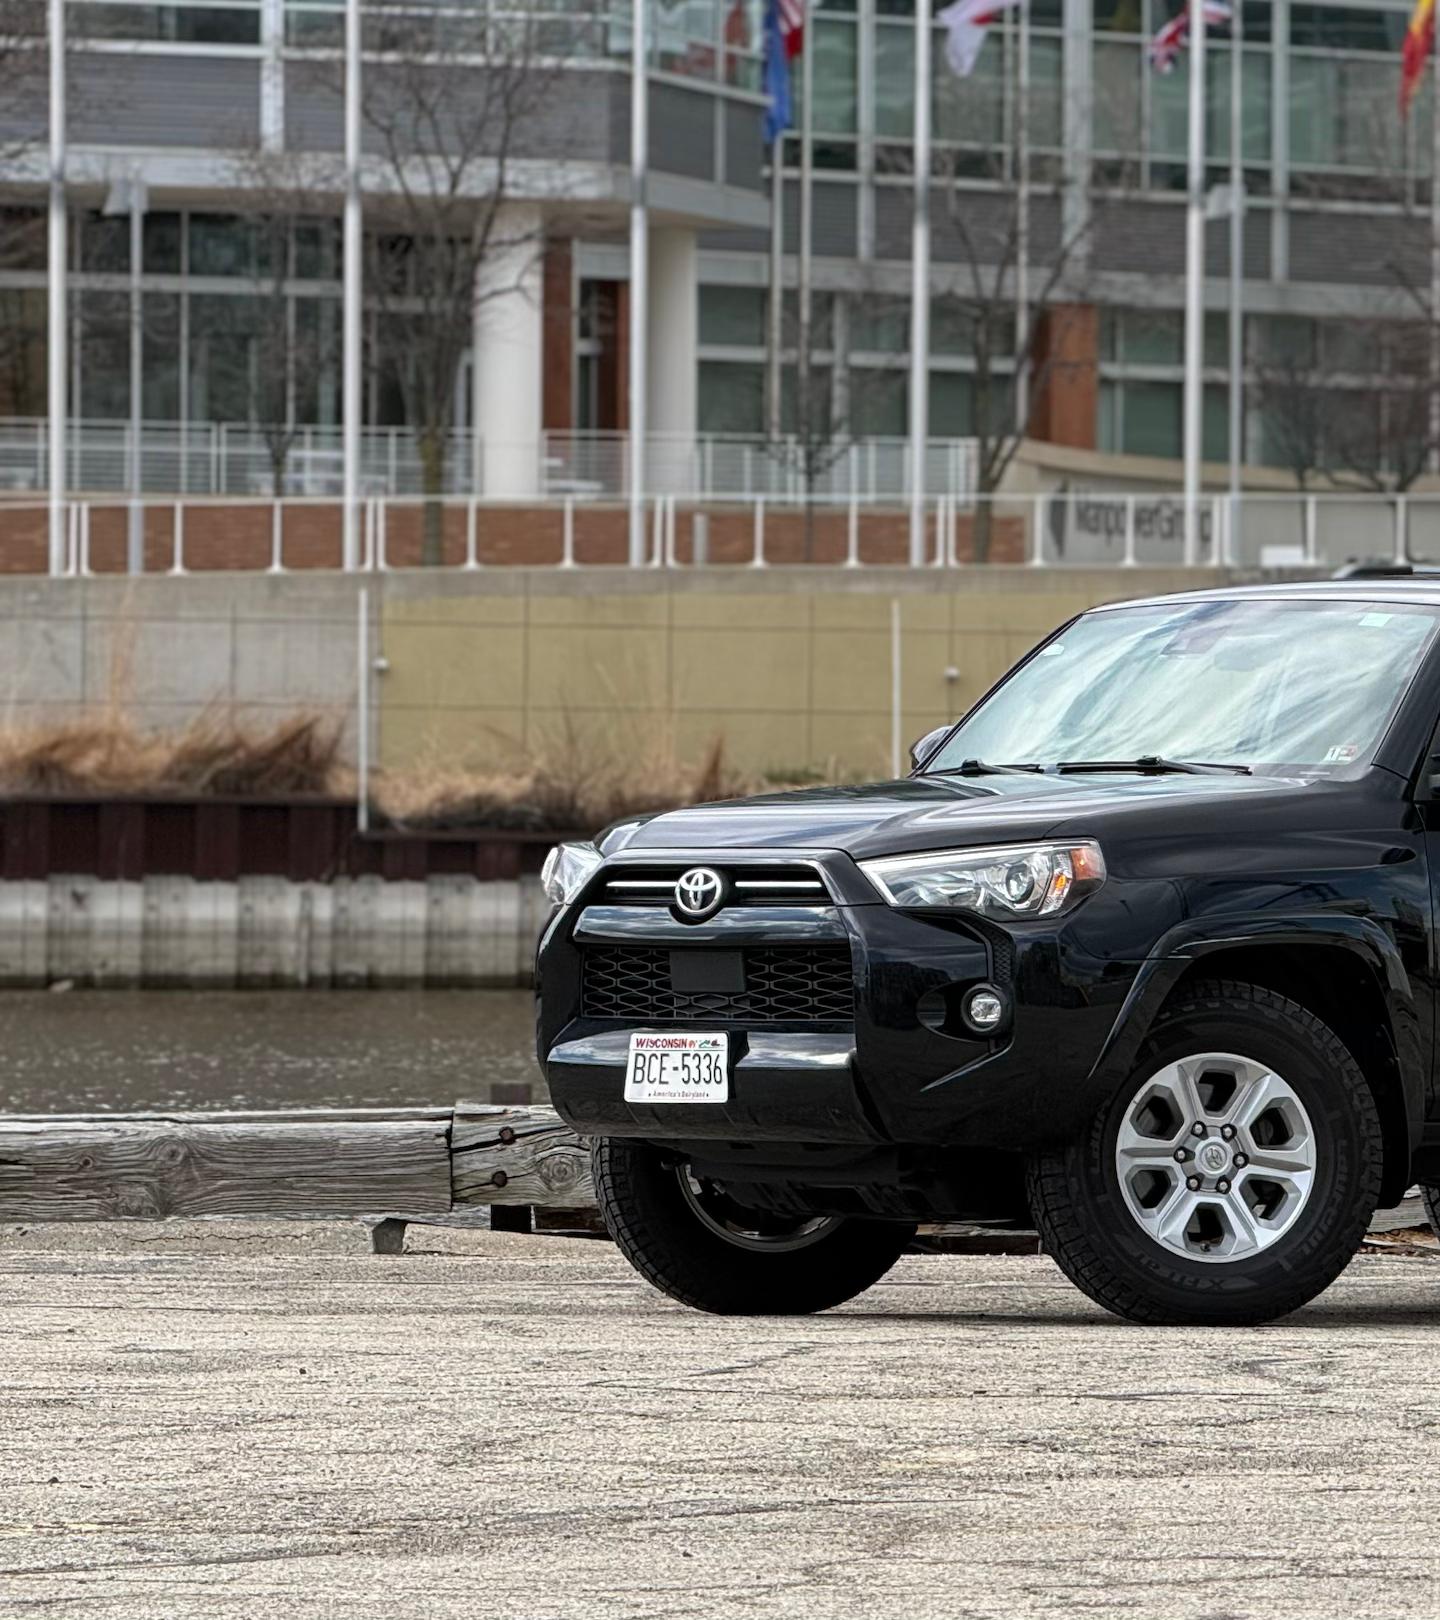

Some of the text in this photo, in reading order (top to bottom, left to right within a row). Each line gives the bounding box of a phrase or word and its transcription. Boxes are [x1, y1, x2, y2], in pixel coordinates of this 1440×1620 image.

[1074, 487, 1214, 549] ManpoerGrp
[636, 1038, 688, 1048] WISCONSIN
[632, 1052, 723, 1085] BCE-5336
